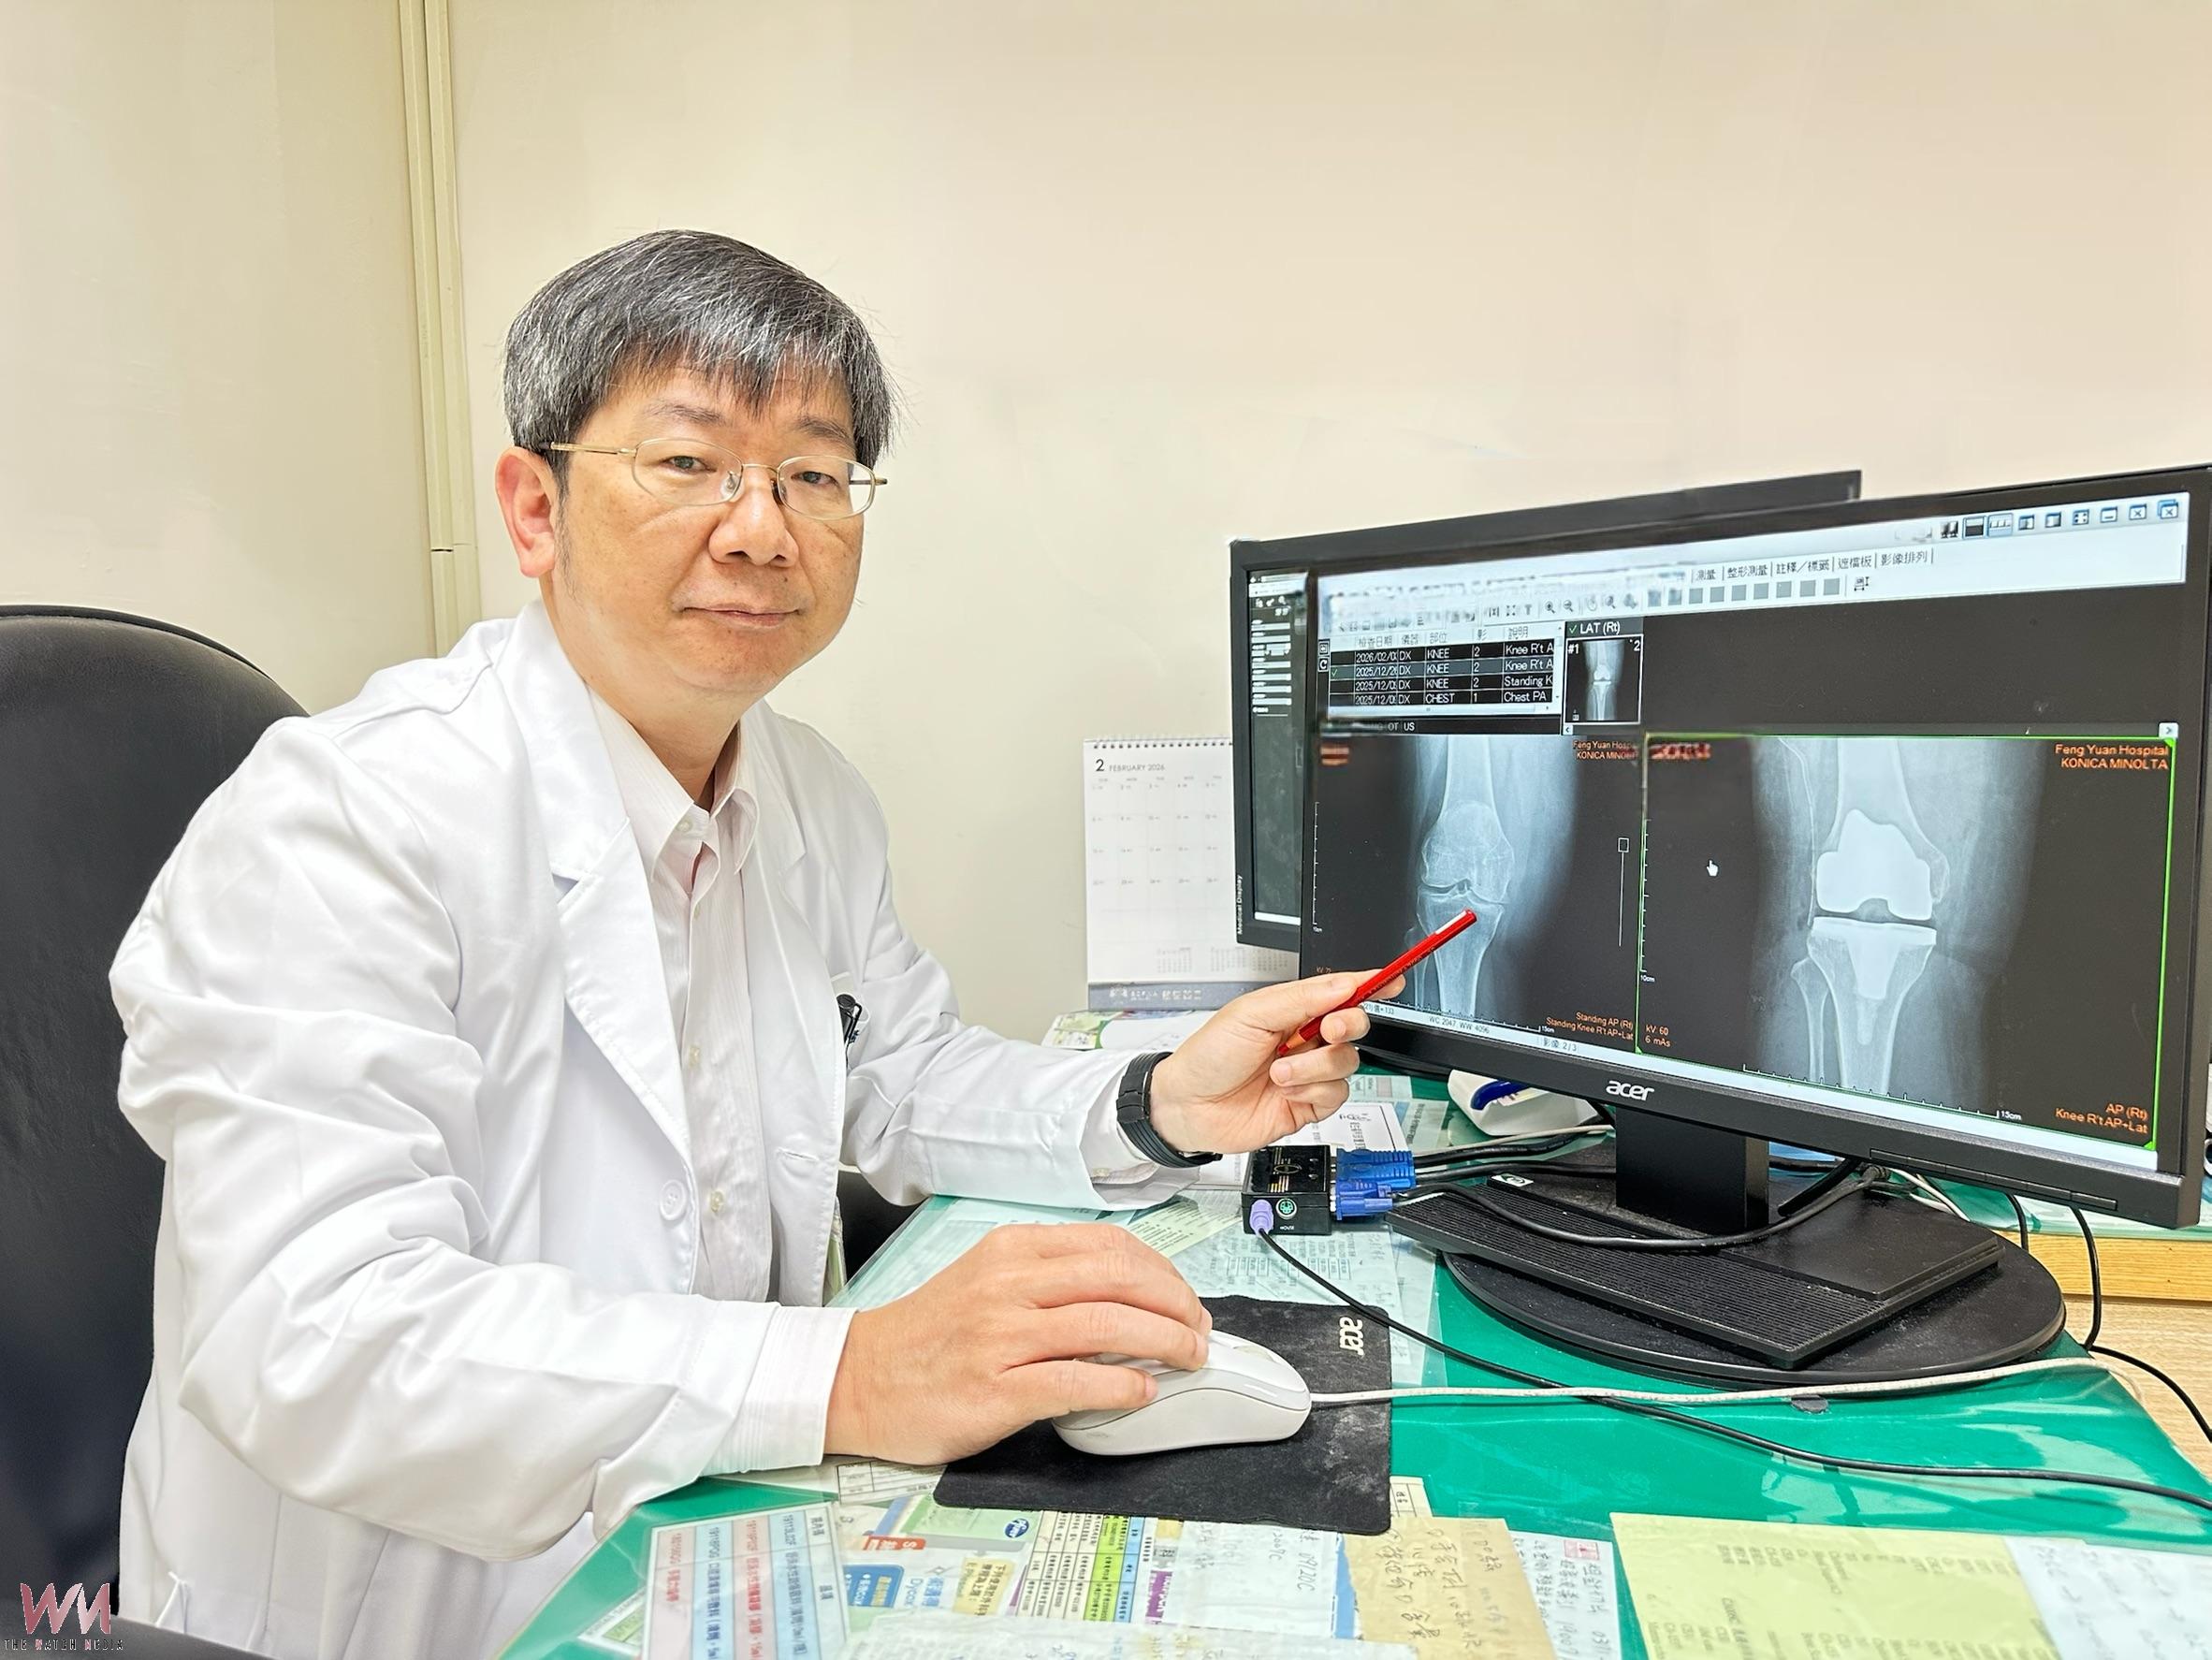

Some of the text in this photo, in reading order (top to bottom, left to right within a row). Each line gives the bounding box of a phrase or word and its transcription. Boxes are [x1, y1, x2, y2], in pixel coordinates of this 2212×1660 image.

[1881, 550, 1928, 566] 影像排列
[1727, 564, 1768, 578] 整形測量
[1580, 621, 1620, 635] LAT (Rt)
[1430, 633, 1447, 644] 部位
[1427, 648, 1449, 659] KNEE
[1474, 647, 1480, 657] 2
[1506, 644, 1528, 654] Knee
[1568, 644, 1579, 654] #1
[1400, 651, 1411, 661] DX
[1400, 665, 1411, 675] DX
[1427, 663, 1449, 674] KNEE
[1474, 662, 1479, 672] 2
[1506, 660, 1527, 670] Knee
[1399, 680, 1410, 690] DX
[1427, 678, 1448, 689] KNEE
[1474, 677, 1478, 687] 2
[1504, 676, 1543, 687] Standing
[1399, 694, 1410, 704] DX
[1426, 692, 1455, 703] CHEST
[1504, 691, 1547, 702] Chest PA
[1388, 723, 1399, 731] OT
[1404, 722, 1415, 731] US
[1573, 741, 1591, 750] Feng
[2055, 744, 2168, 757] Feng Yuan Hospital
[1577, 751, 1605, 760] KONICA
[1096, 759, 1104, 772] 2
[2061, 757, 2168, 769] KONICA MINOLTA
[1546, 1017, 1576, 1032] Standing
[1577, 1023, 1595, 1034] Knee
[1576, 1012, 1634, 1031] Standing AP (Rt)
[1659, 1026, 1669, 1036] 60
[1645, 1035, 1671, 1048] 6 mAs
[1606, 1080, 1655, 1101] acer
[2001, 1110, 2022, 1121] 15cm
[2106, 1103, 2148, 1121] AP (Rt)
[2055, 1108, 2148, 1134] Knee R't AP+Lat
[1339, 1317, 1364, 1355] acer
